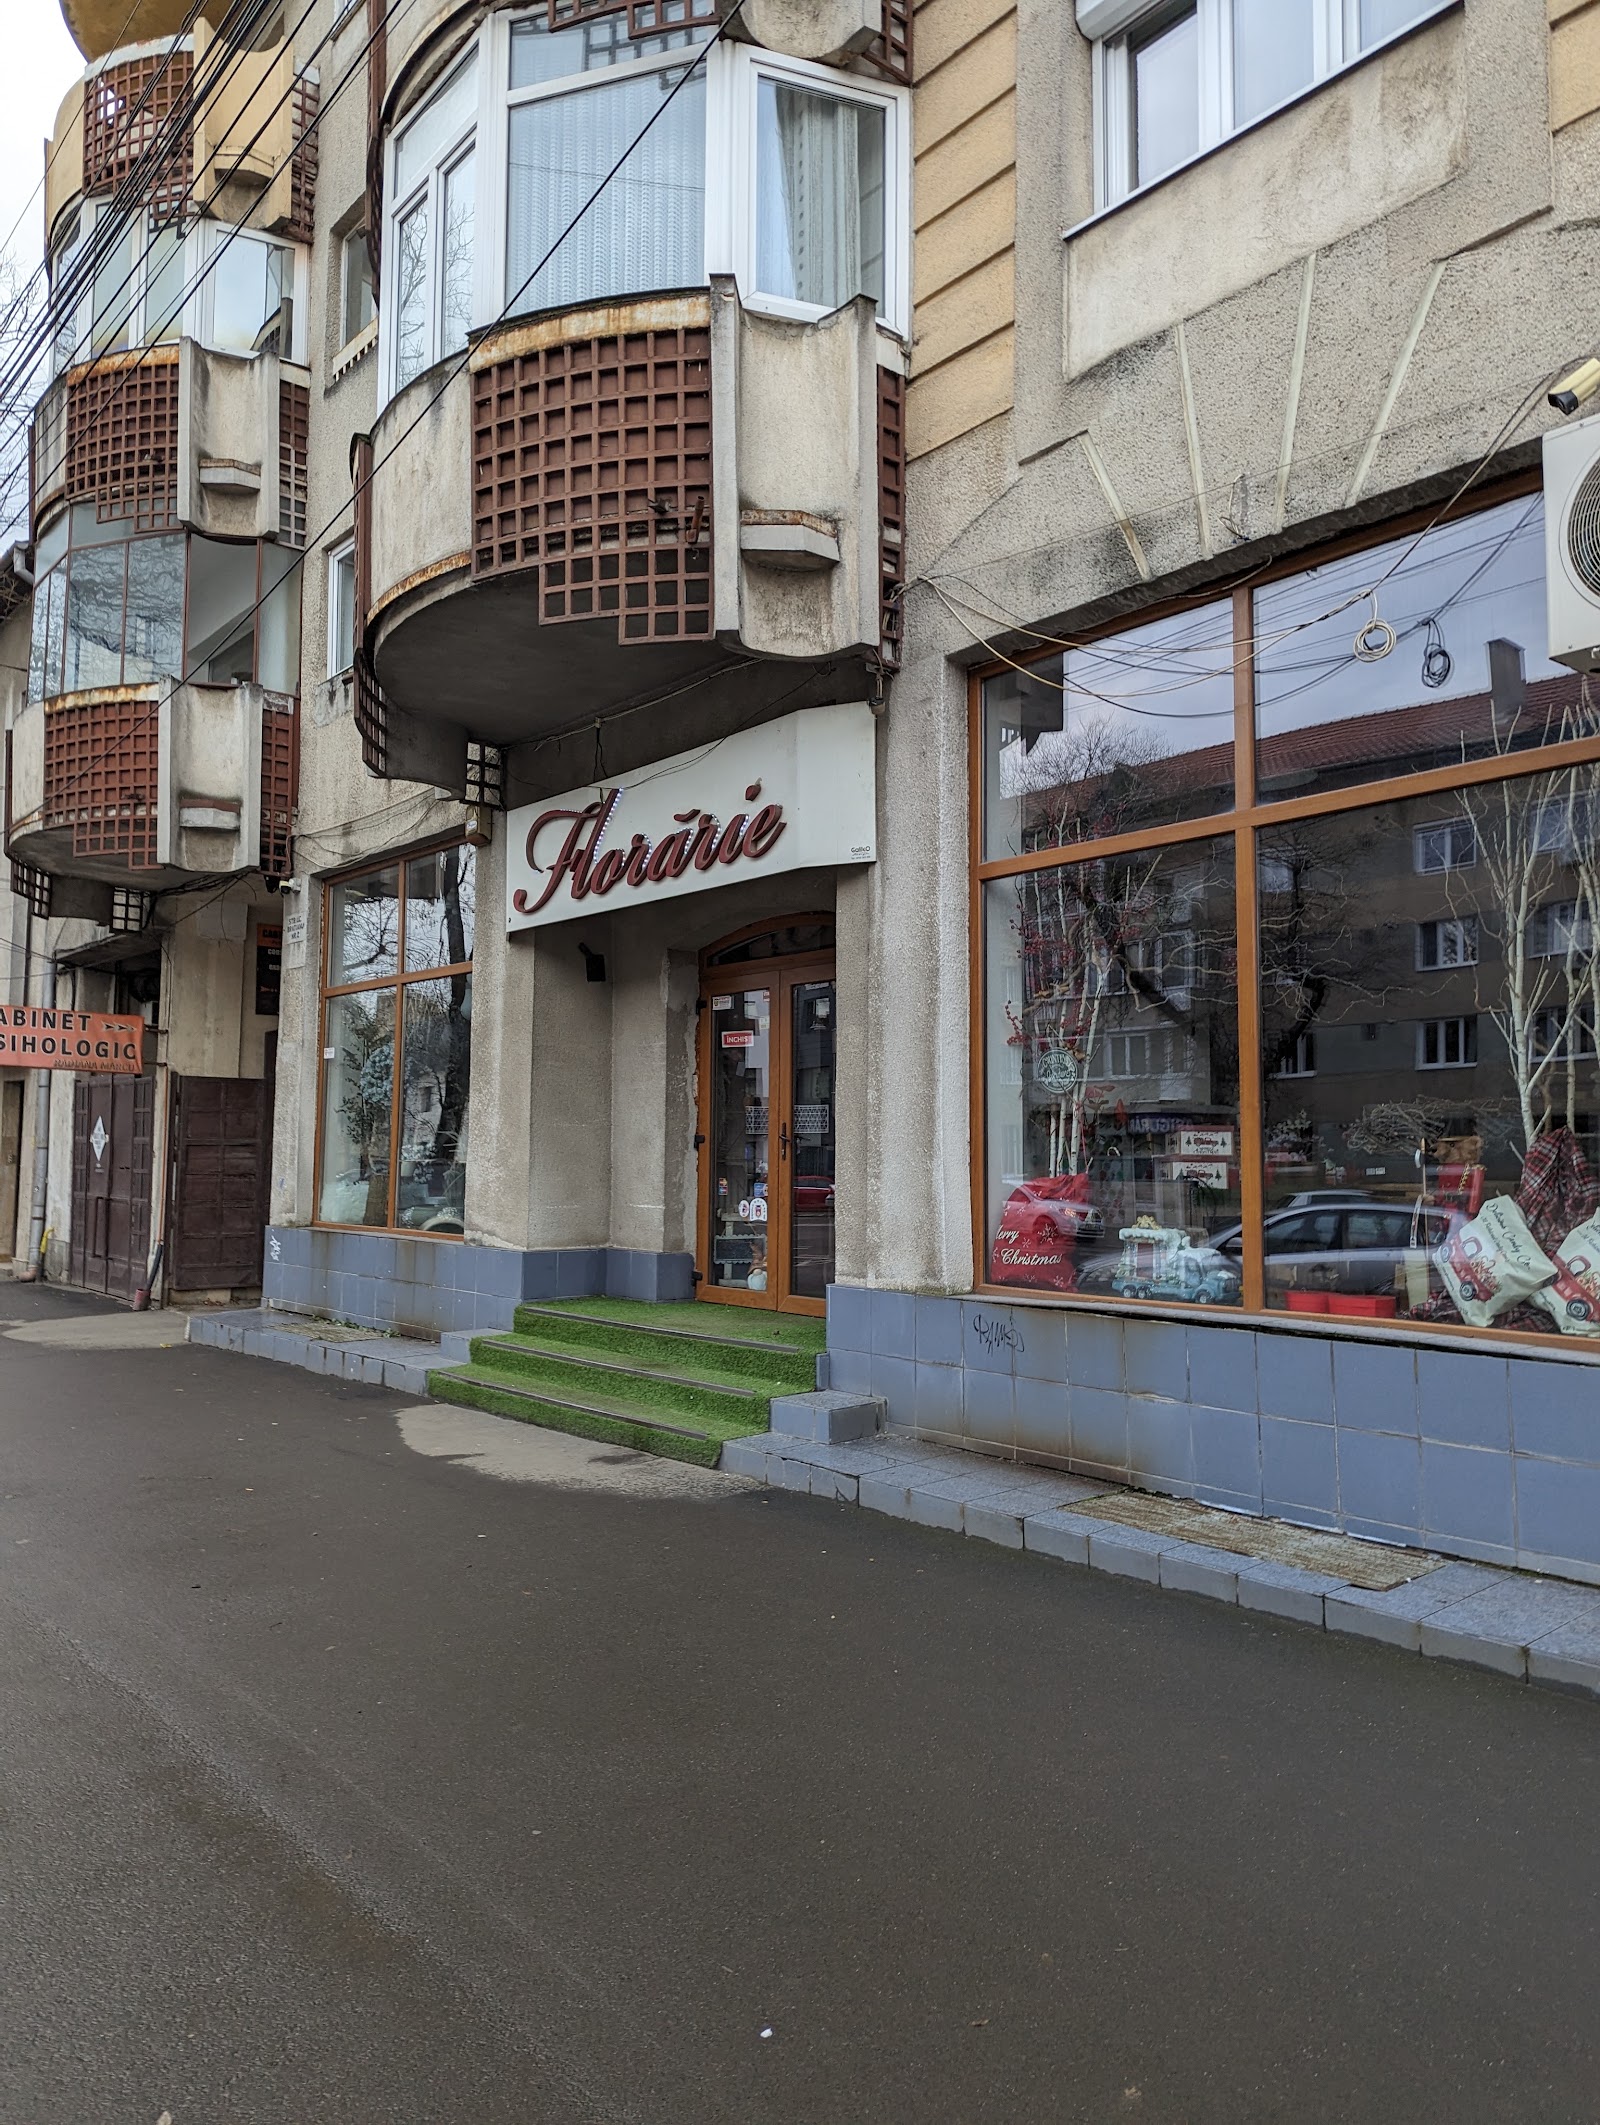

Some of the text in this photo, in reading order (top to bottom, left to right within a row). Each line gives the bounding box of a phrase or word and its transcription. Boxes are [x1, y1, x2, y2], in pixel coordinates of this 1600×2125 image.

[513, 778, 787, 914] Florărie
[995, 1225, 1020, 1244] erry
[1000, 1248, 1063, 1265] Christmas
